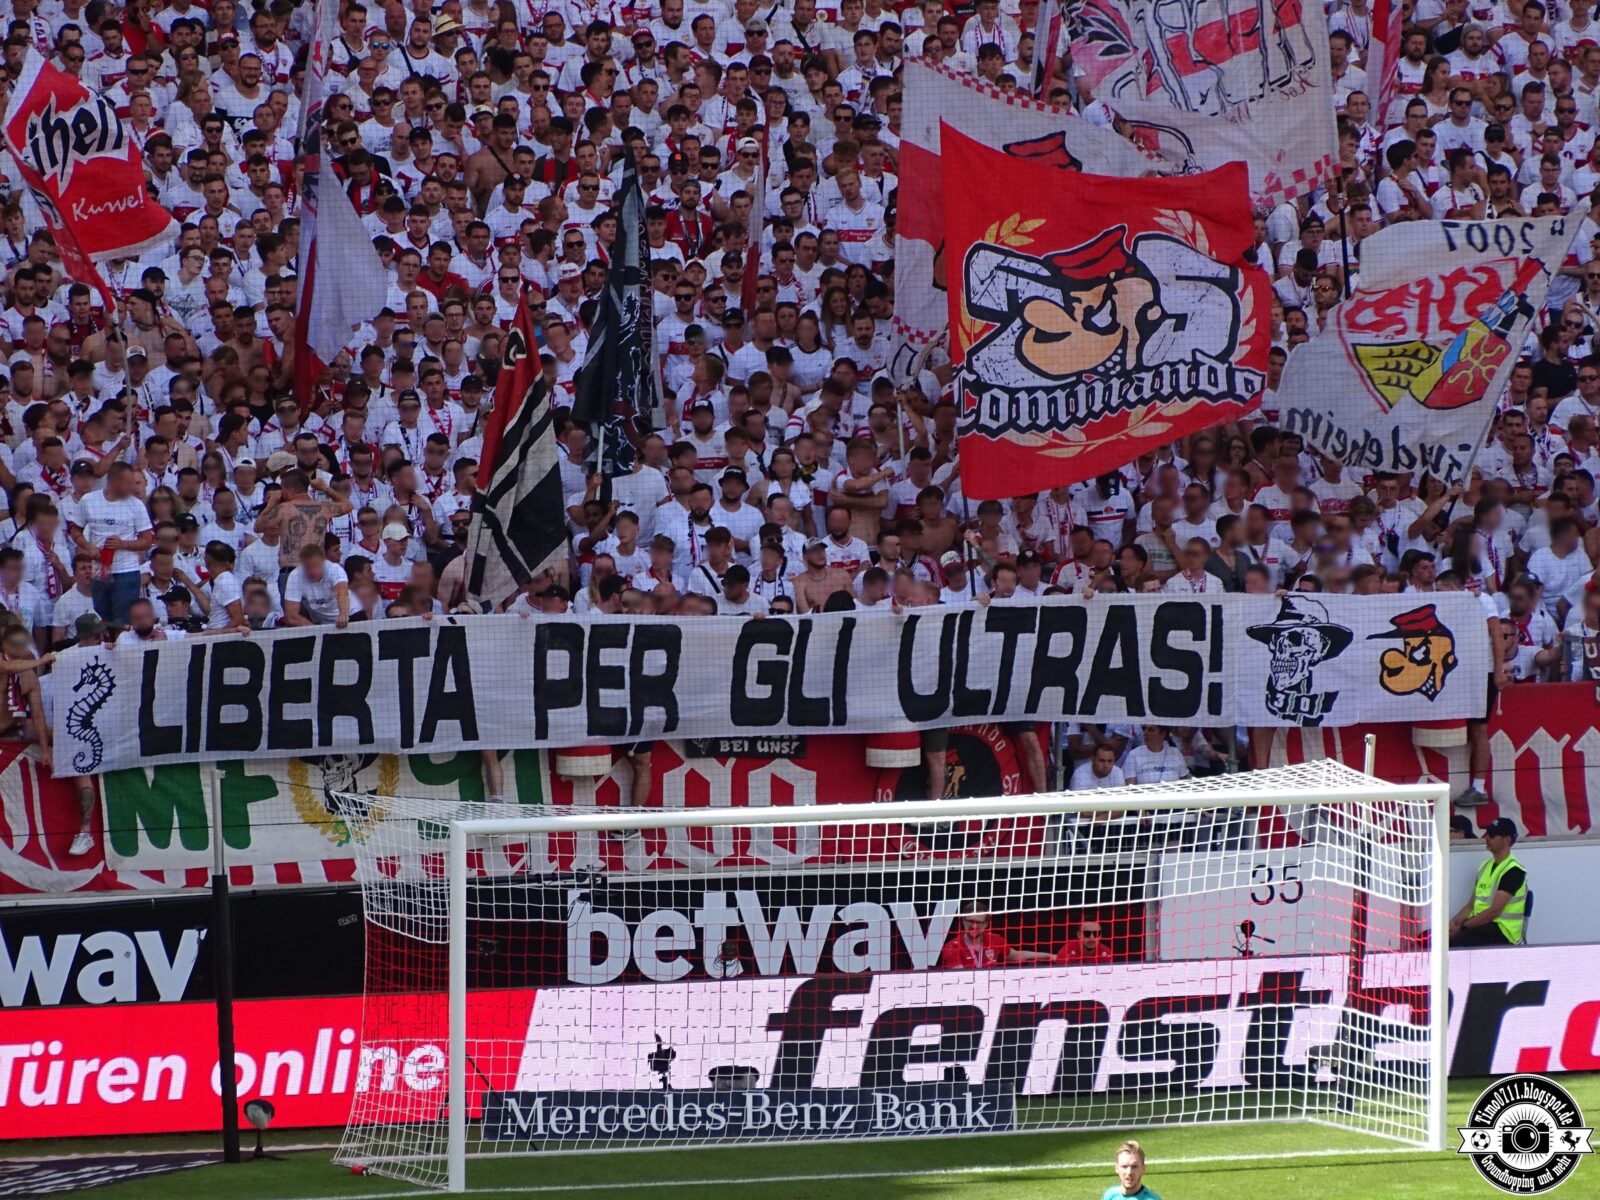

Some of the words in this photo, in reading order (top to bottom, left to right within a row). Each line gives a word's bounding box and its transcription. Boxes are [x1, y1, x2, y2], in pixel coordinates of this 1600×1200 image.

[953, 349, 1267, 432] Commando
[534, 622, 682, 740] PER
[730, 617, 856, 727] GLI
[897, 601, 1224, 723] ULTRAS!
[719, 740, 749, 752] BEI
[756, 740, 800, 755] UNS!
[1251, 864, 1304, 906] 35
[567, 888, 960, 984] betway
[0, 1040, 188, 1107] Türen
[211, 1026, 447, 1099] online
[503, 1092, 855, 1137] Mercedes-Benz
[872, 1090, 993, 1131] Bank
